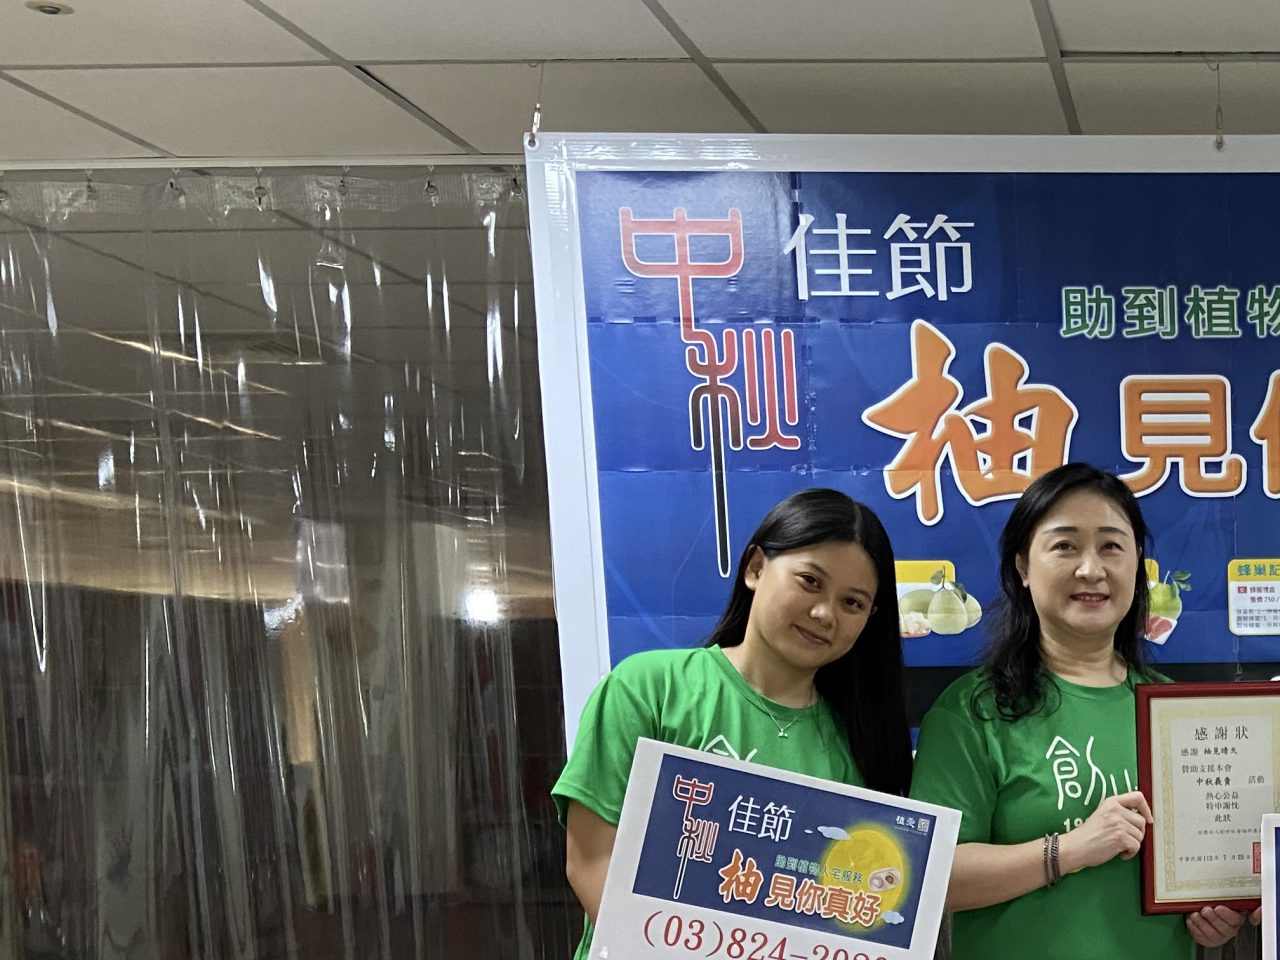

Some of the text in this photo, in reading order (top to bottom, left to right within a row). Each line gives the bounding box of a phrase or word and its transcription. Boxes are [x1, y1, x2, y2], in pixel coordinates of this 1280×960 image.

[782, 213, 976, 302] 佳節
[619, 206, 803, 578] 中秋
[1195, 726, 1248, 740] 感謝狀
[672, 774, 719, 899] 中秋
[728, 795, 796, 843] 佳節
[718, 848, 882, 927] 柚見你真好
